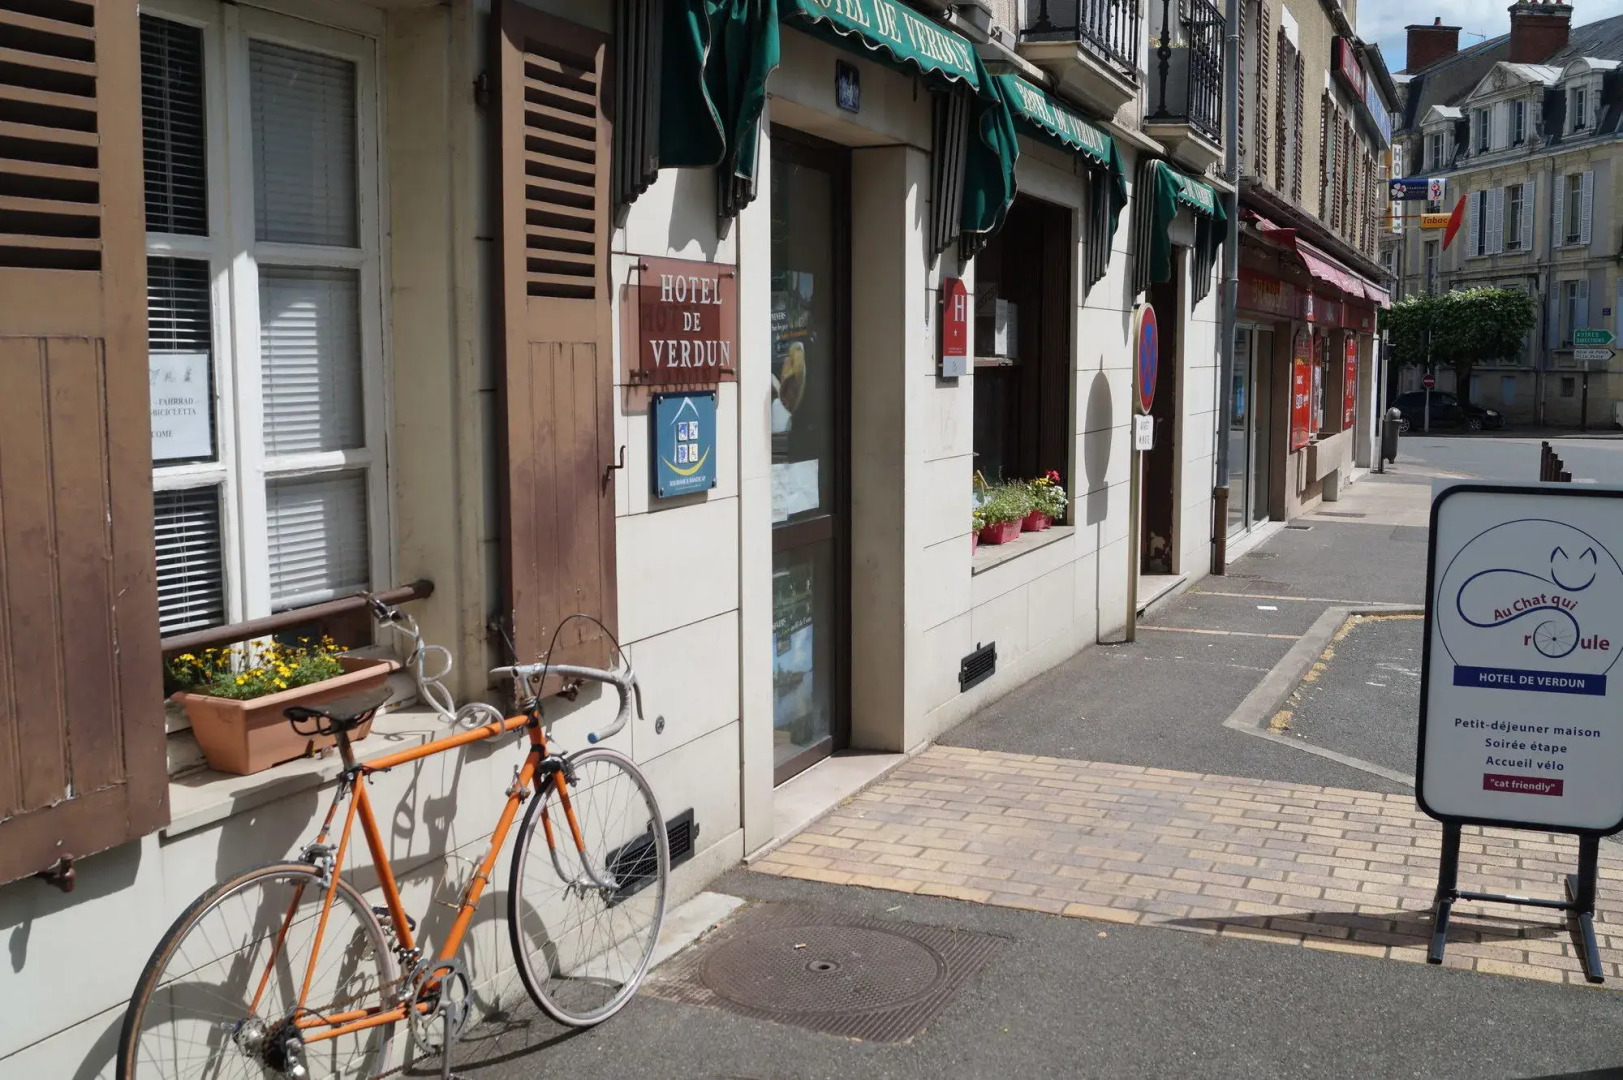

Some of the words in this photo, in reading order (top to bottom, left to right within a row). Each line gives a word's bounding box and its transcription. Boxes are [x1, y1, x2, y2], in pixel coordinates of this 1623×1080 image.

[874, 0, 902, 43] DE
[902, 12, 975, 74] VERDUN
[1422, 216, 1448, 224] Tabac
[660, 274, 723, 305] HOTEL
[954, 294, 965, 322] H
[683, 312, 701, 332] DE
[649, 340, 730, 368] VERDUN
[151, 430, 173, 438] COME
[1494, 609, 1512, 621] Au
[1513, 593, 1547, 612] Chat
[1551, 595, 1578, 611] qui
[1479, 673, 1516, 684] HOTEL
[1519, 676, 1534, 685] DE
[1537, 677, 1586, 689] VERDUN
[1454, 718, 1550, 735] Petit-déjeuner
[1553, 726, 1601, 738] maison
[1485, 738, 1527, 750] Soirée
[1530, 740, 1568, 754] étape
[1485, 756, 1533, 769] Accueil
[1536, 760, 1565, 771] vélo
[1490, 778, 1510, 788] "cat
[1511, 780, 1556, 793] friendly"
